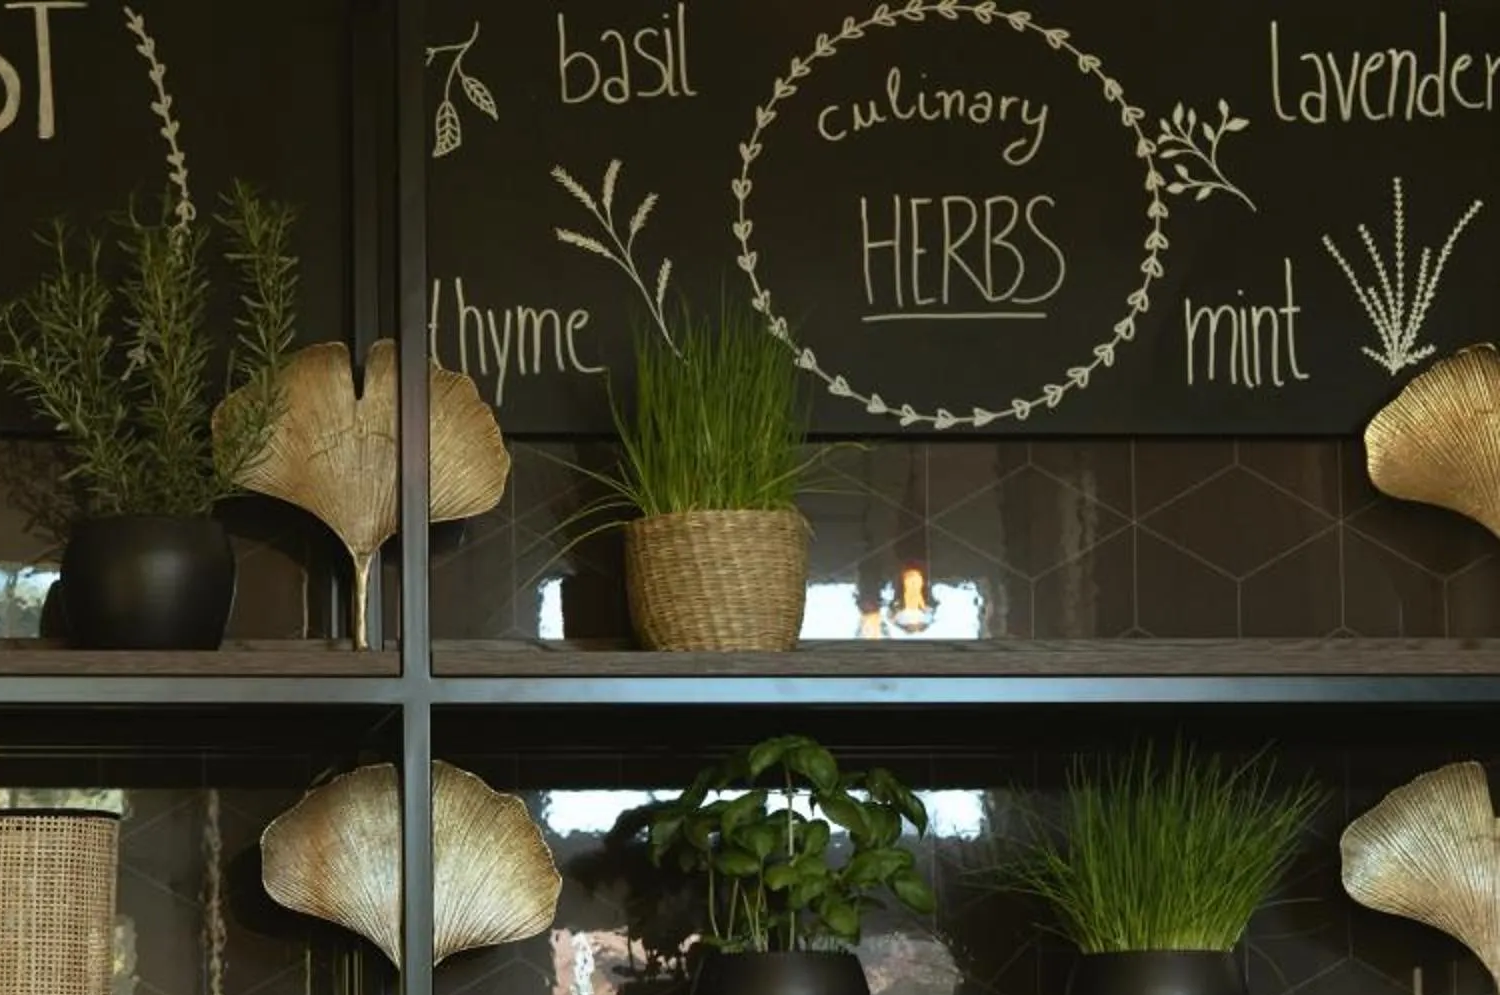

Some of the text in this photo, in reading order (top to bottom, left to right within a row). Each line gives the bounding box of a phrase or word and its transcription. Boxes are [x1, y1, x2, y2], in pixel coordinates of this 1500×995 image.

[557, 2, 697, 104] basil
[1270, 10, 1500, 124] lavender
[817, 66, 1049, 166] culinary
[860, 194, 1066, 308] HERBS
[428, 276, 605, 407] thyme
[1184, 257, 1310, 389] mint
